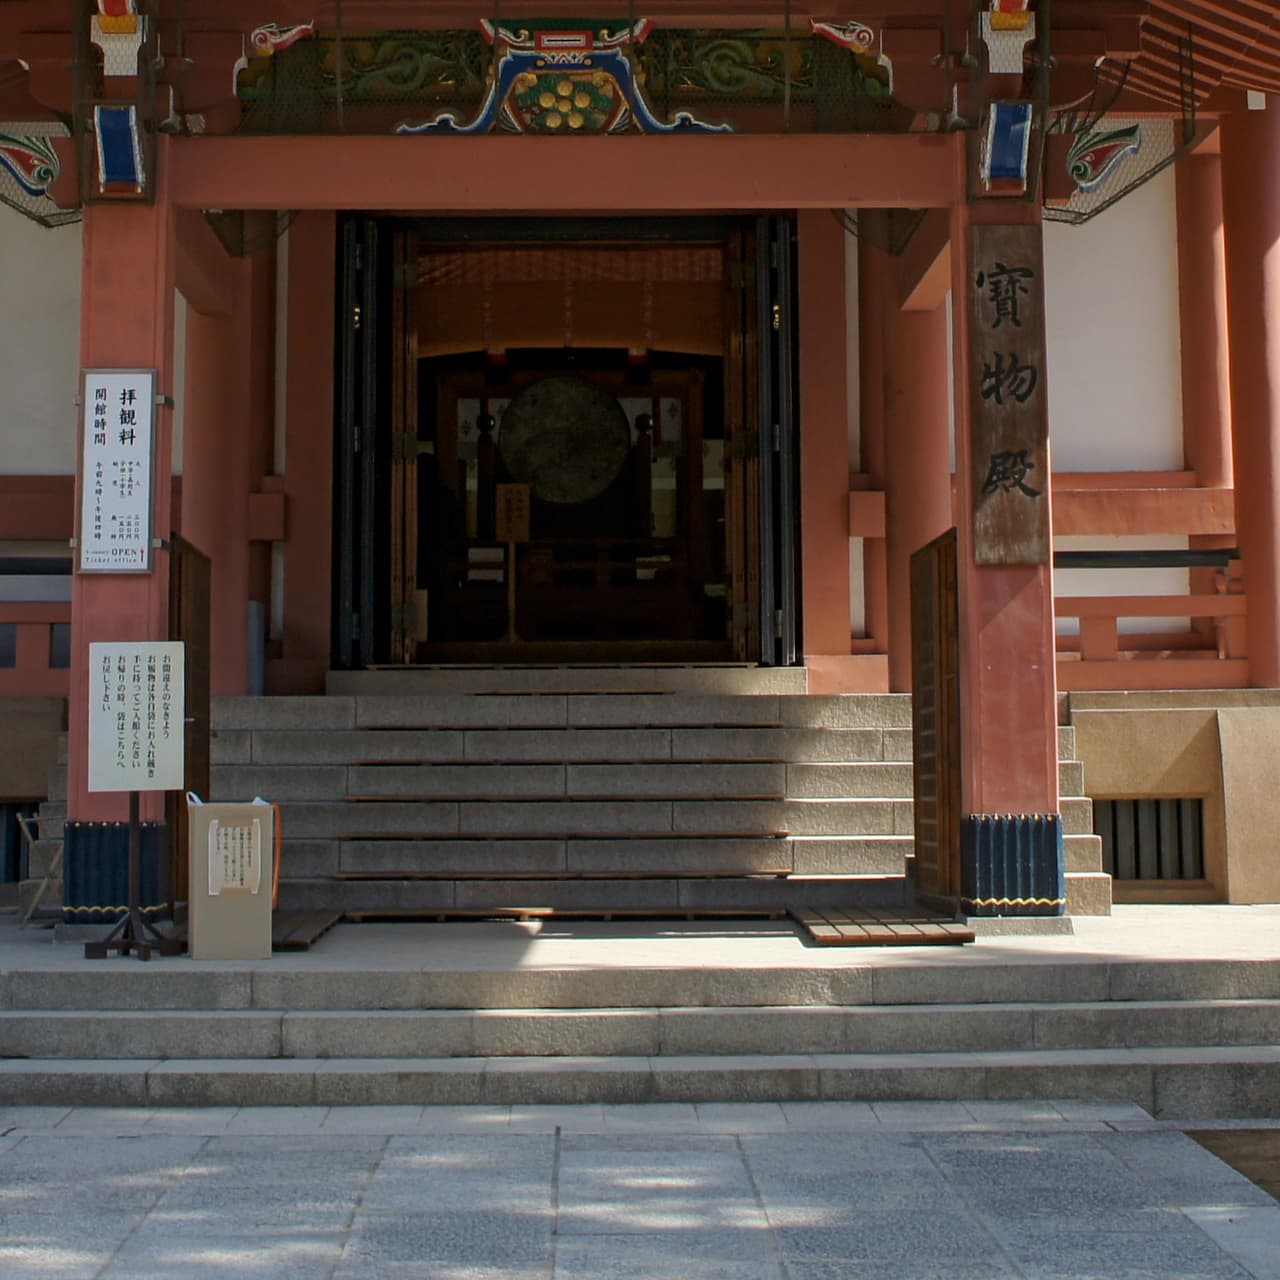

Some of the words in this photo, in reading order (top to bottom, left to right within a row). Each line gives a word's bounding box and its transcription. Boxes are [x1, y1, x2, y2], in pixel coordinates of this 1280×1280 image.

[94, 388, 107, 446] 開館時間
[119, 388, 137, 446] 拝観料
[111, 548, 137, 556] OPEN
